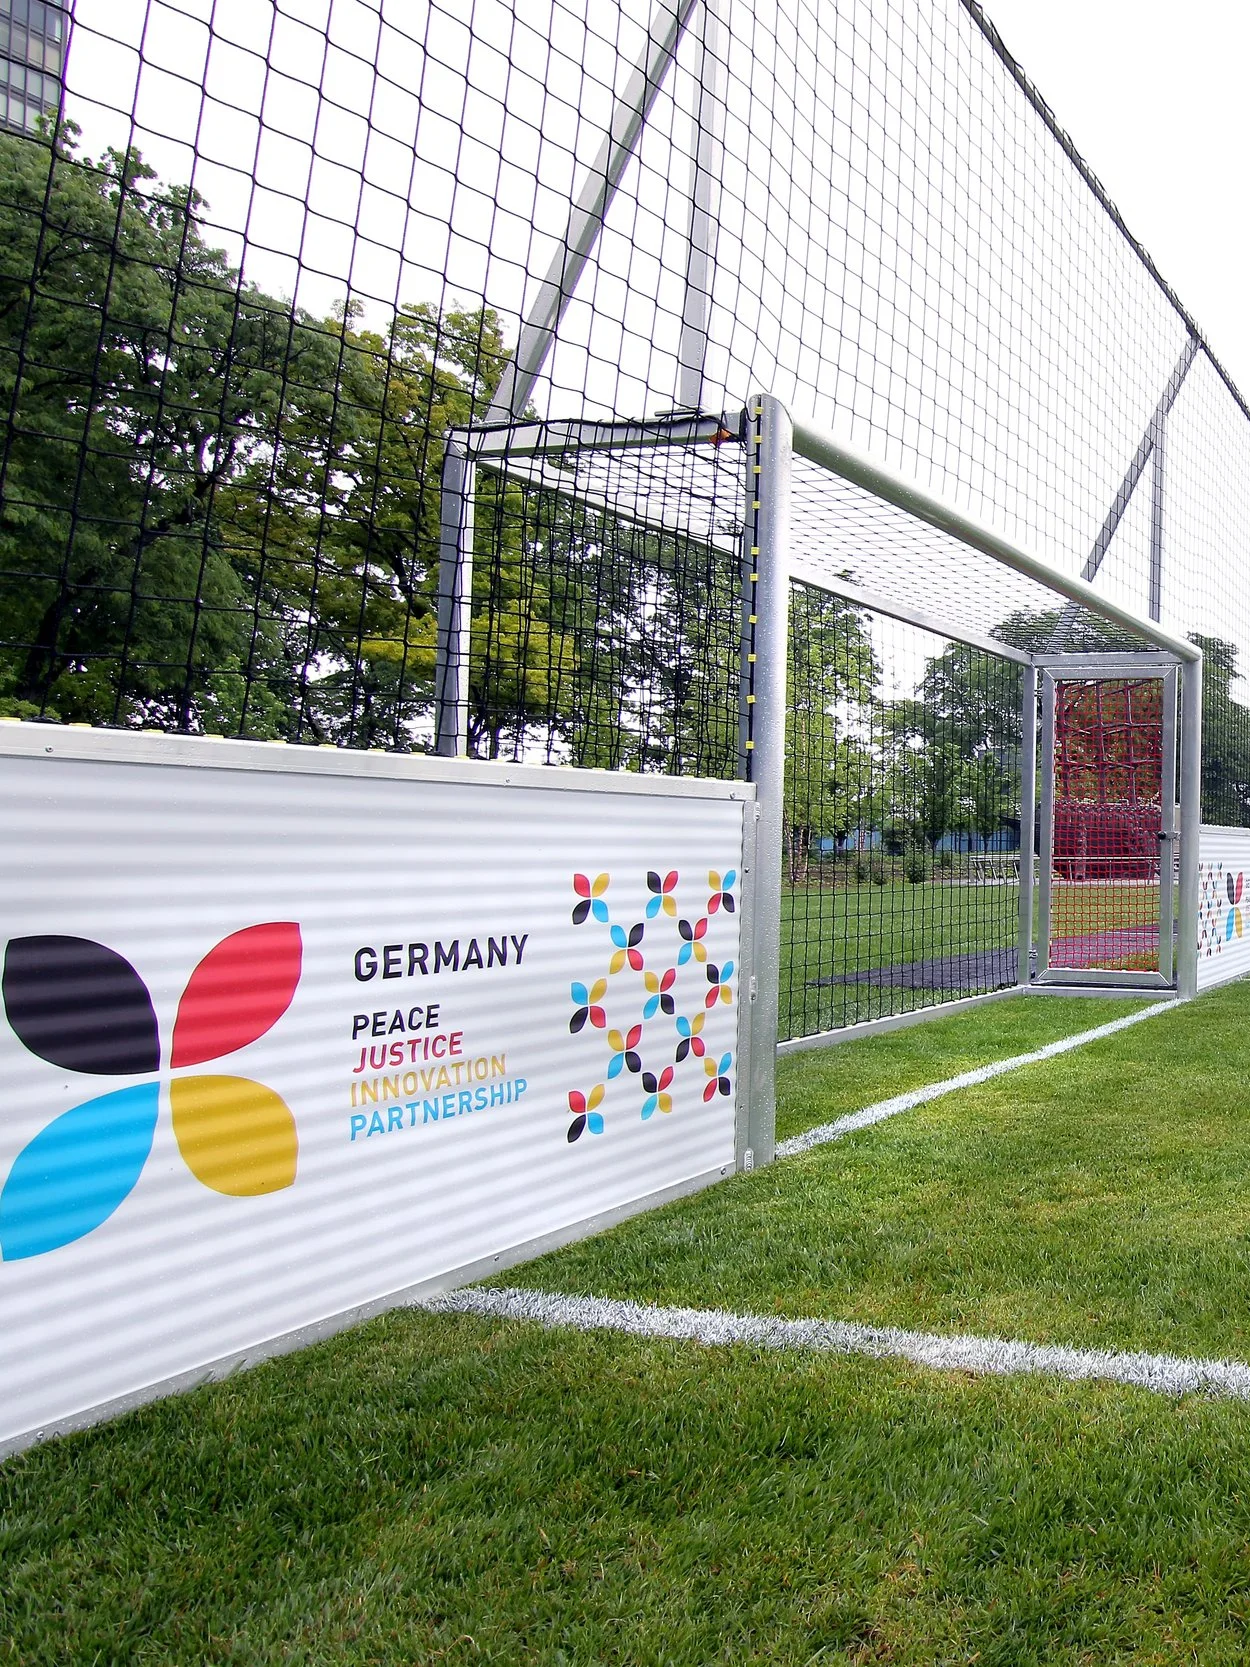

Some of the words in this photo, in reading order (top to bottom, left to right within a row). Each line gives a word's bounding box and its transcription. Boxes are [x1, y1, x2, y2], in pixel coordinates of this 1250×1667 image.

[354, 934, 529, 982] GERMANY
[352, 1004, 440, 1040] PEACE
[352, 1031, 464, 1074] JUSTICE
[351, 1054, 506, 1107] INNOVATION
[350, 1078, 528, 1141] PARTNERSHIP
